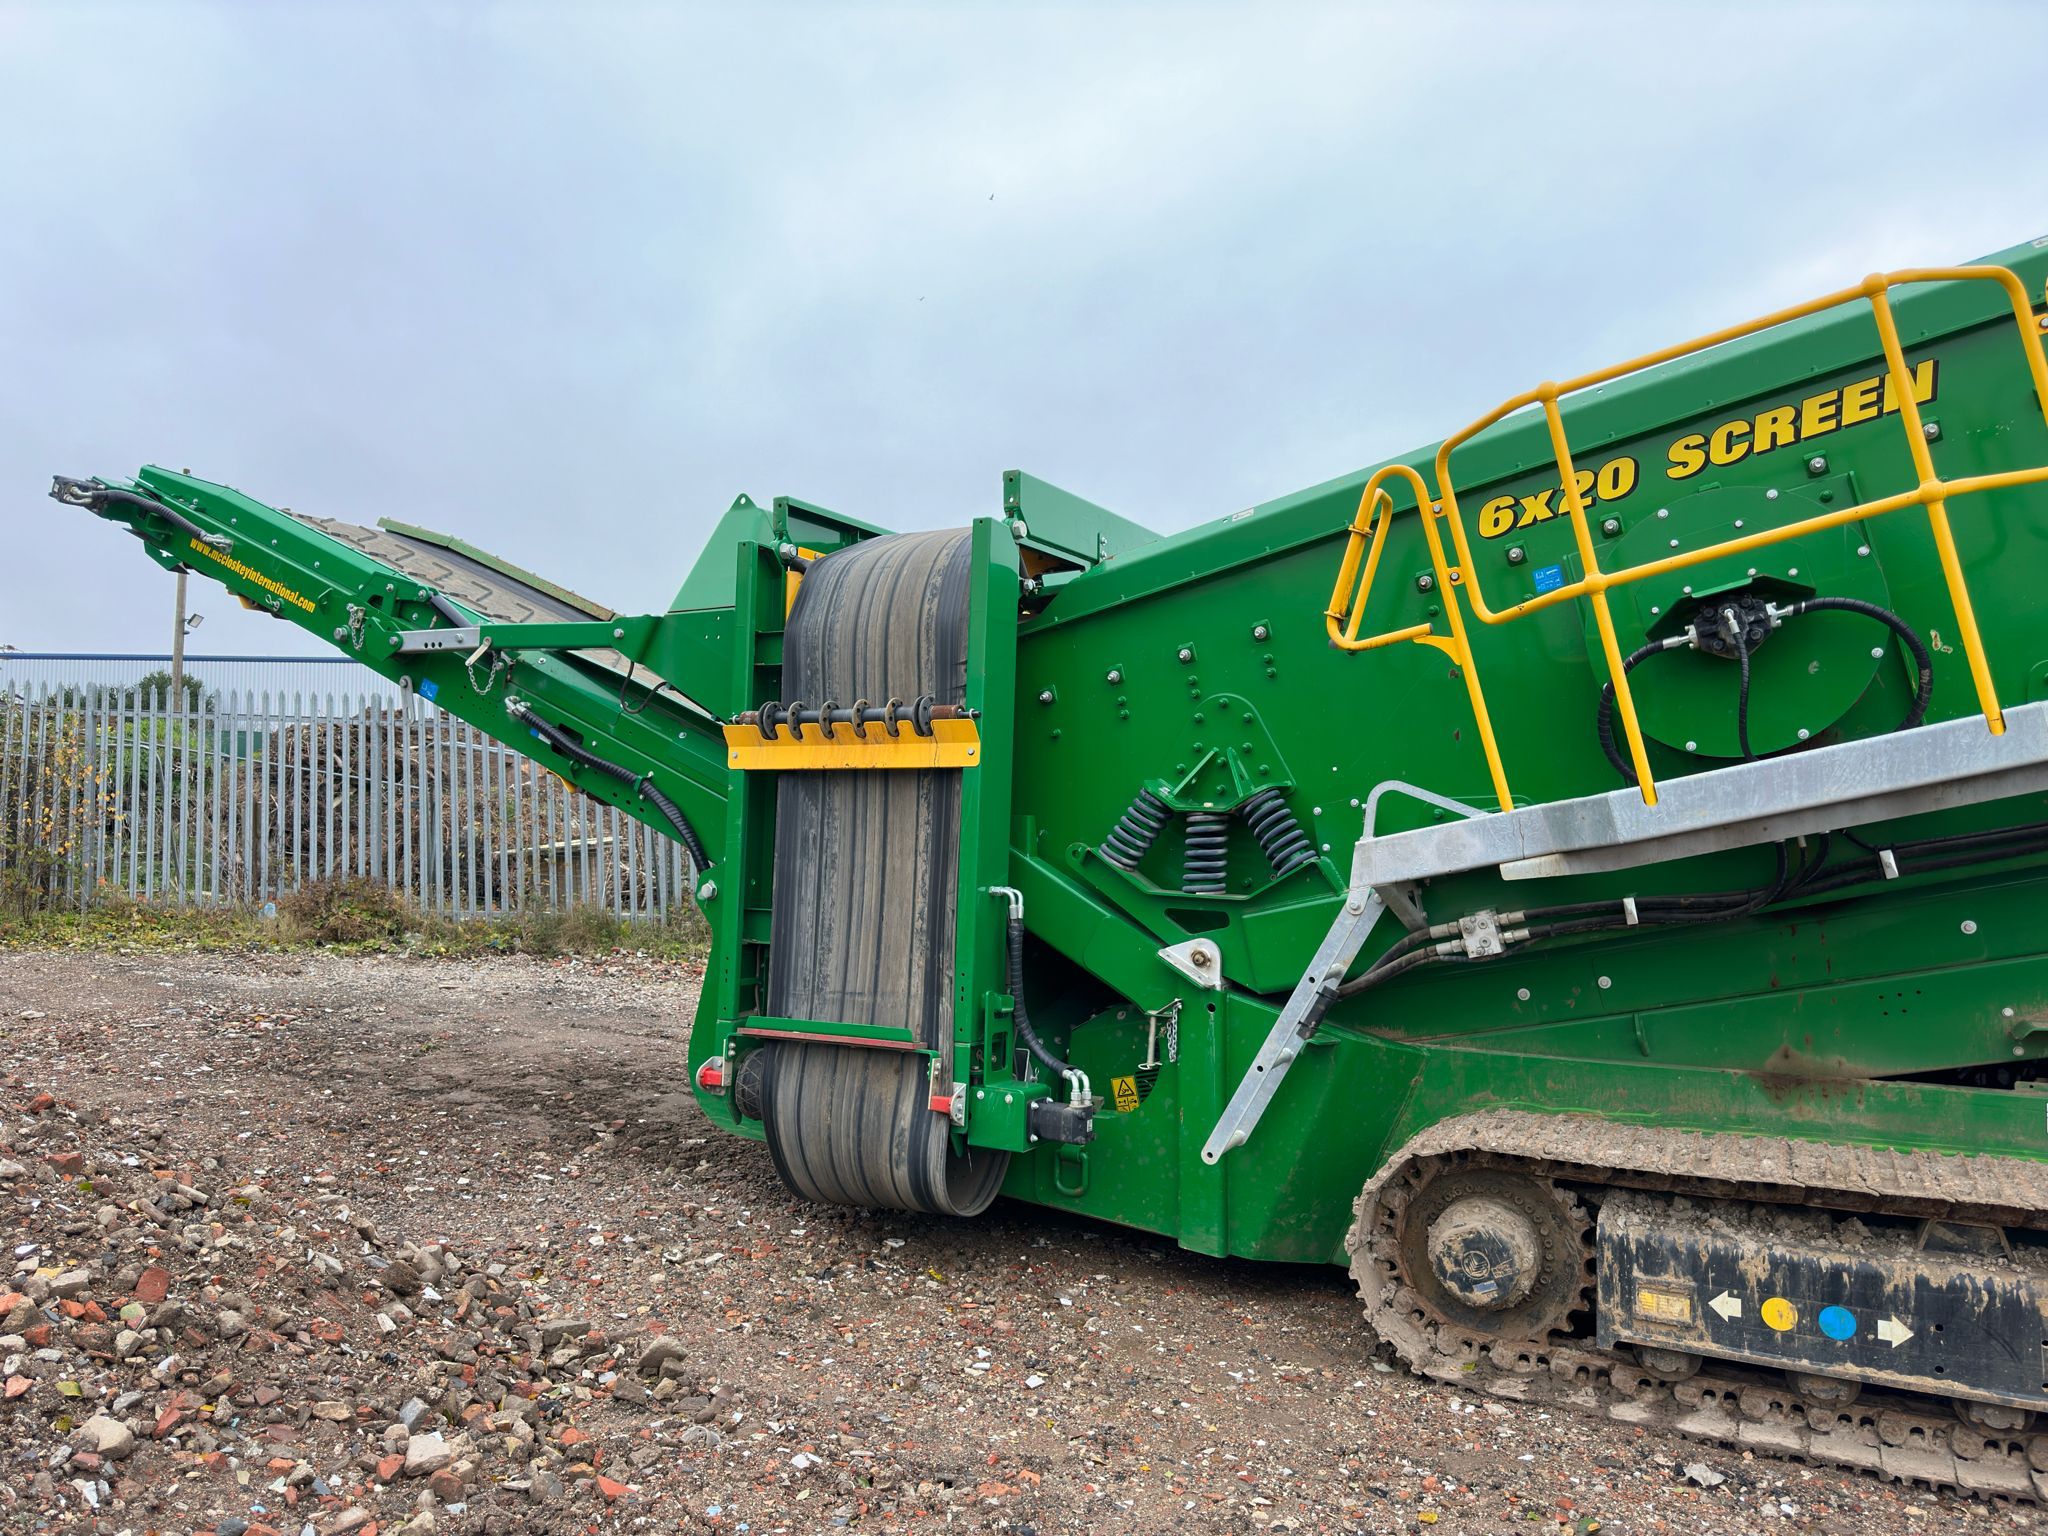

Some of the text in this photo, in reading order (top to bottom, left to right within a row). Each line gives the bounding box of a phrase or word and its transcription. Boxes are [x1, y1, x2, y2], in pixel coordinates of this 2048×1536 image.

[1478, 358, 1939, 539] 6x20 SCREEN
[189, 537, 317, 614] www.mccloskeyinternational.com
